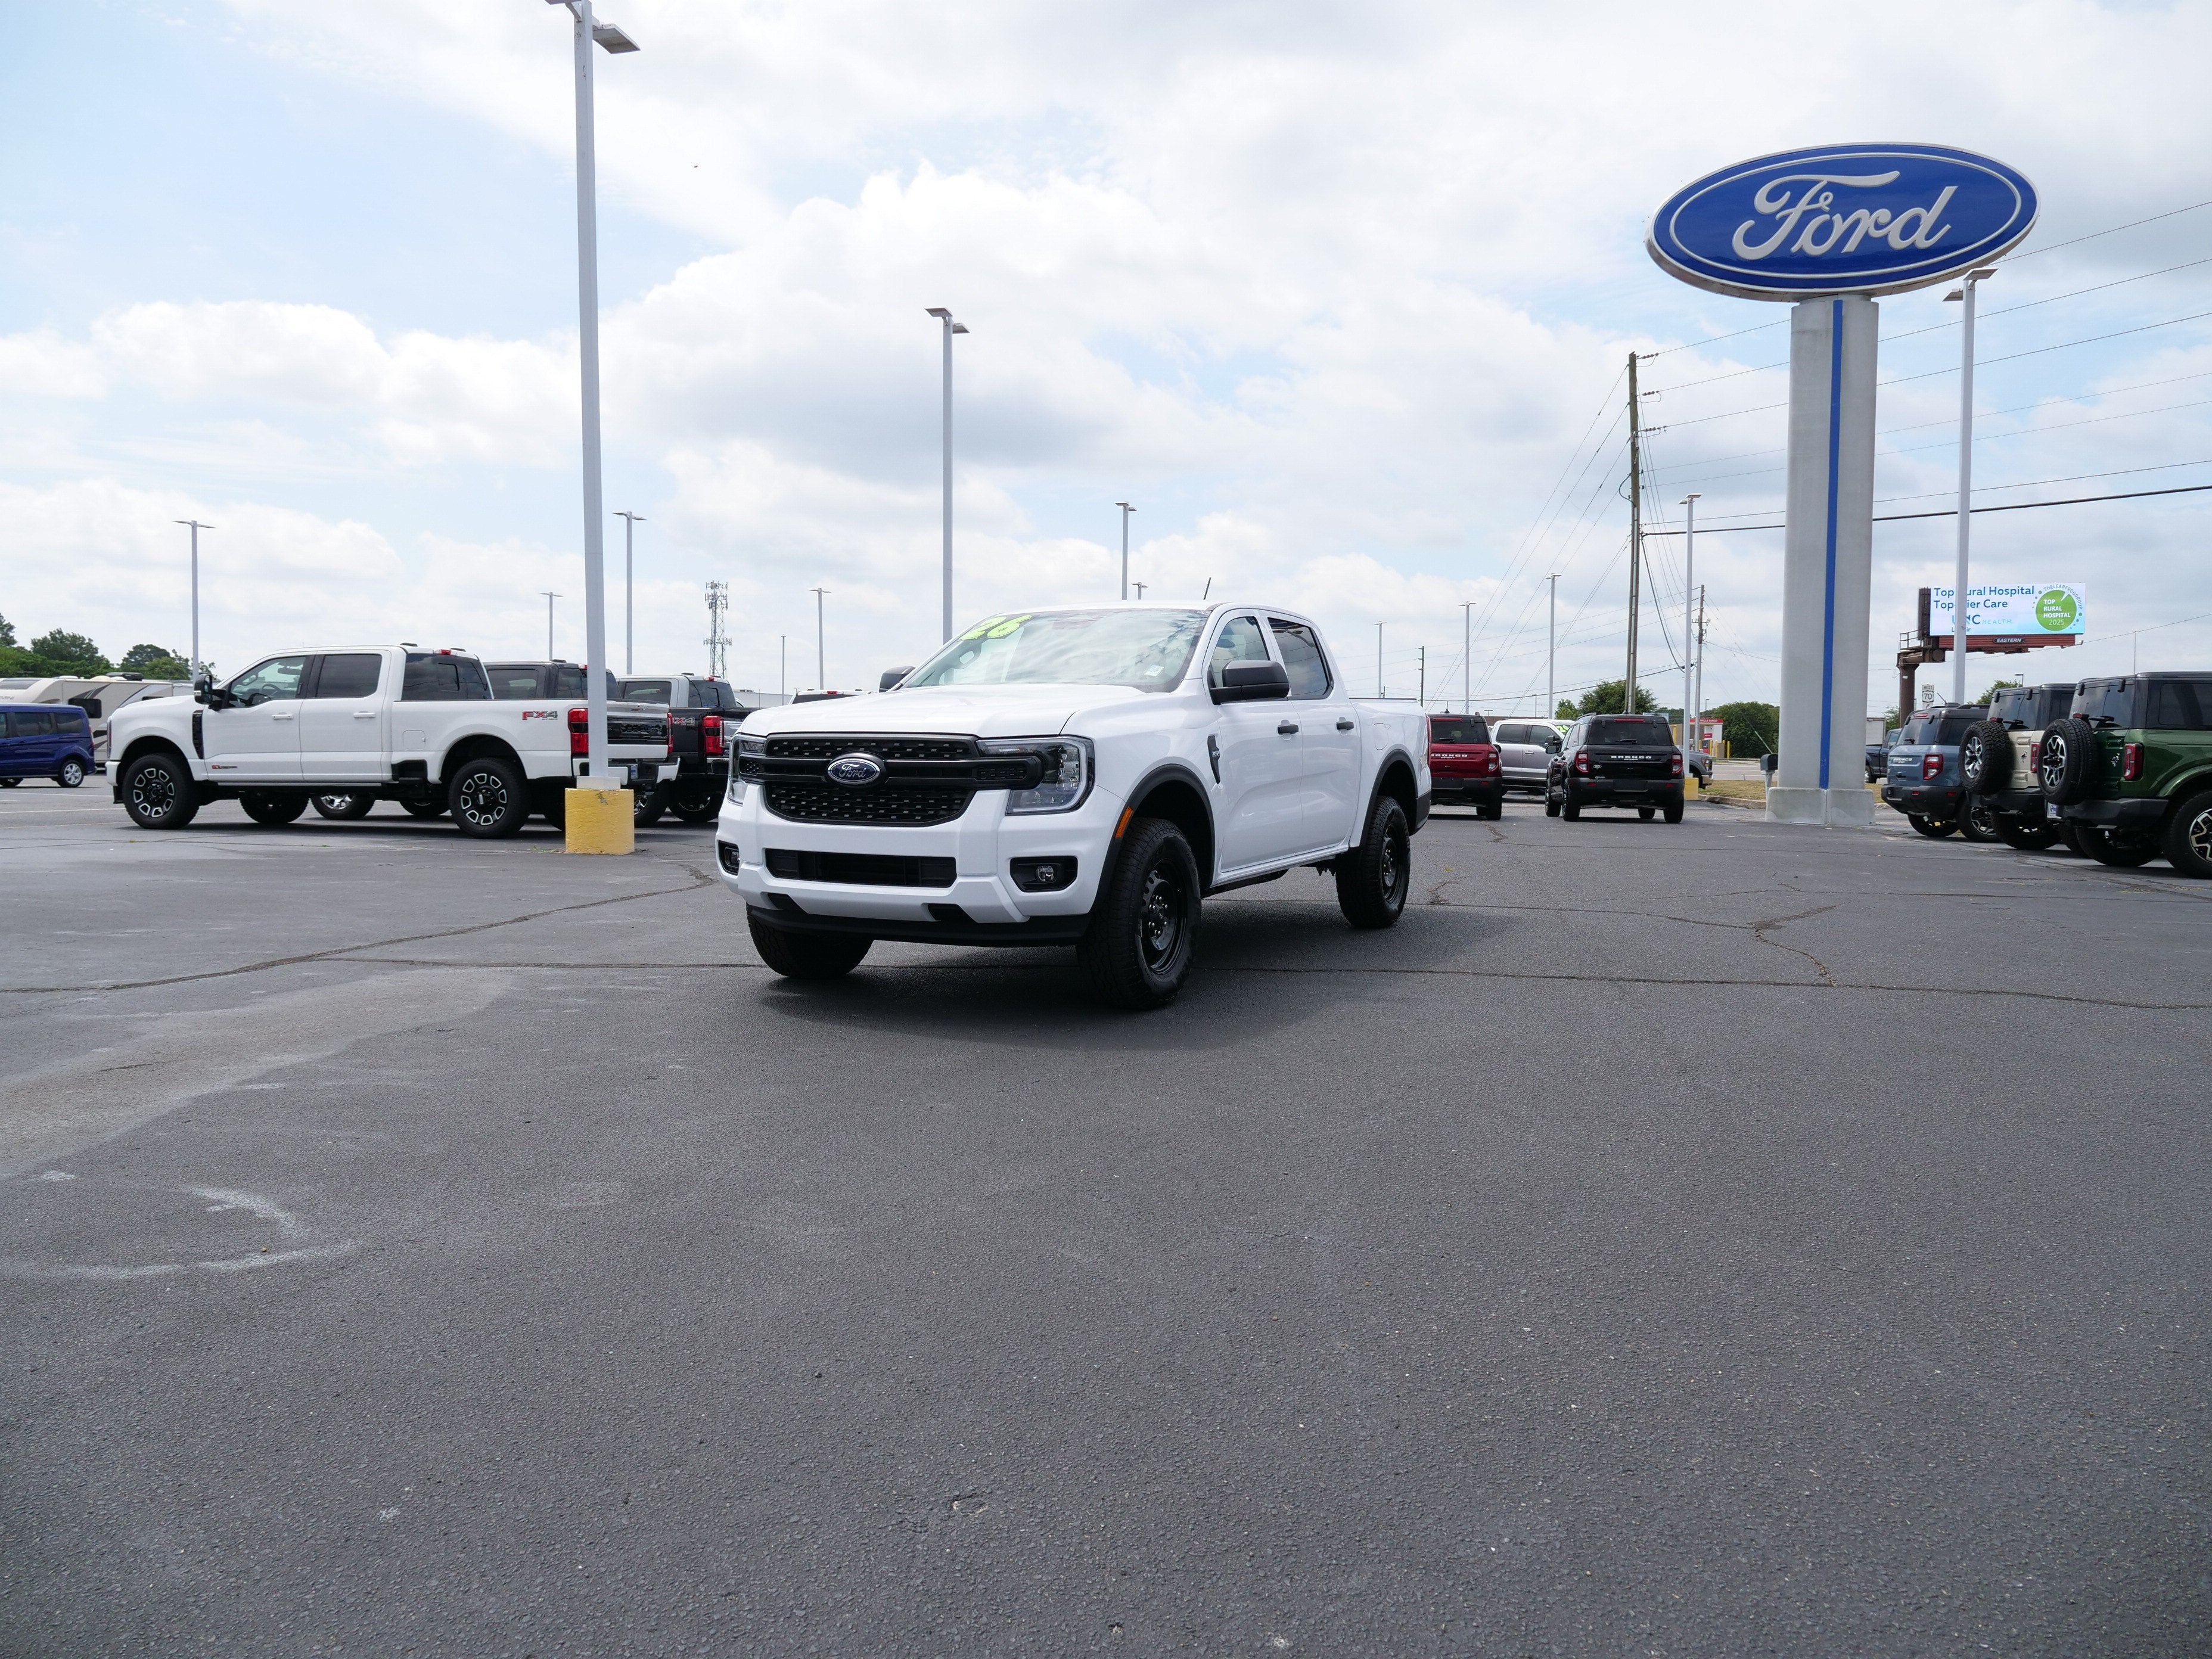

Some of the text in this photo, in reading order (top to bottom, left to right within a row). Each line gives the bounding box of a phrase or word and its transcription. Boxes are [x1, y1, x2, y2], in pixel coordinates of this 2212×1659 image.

[1732, 170, 1959, 260] Ford
[1934, 586, 2034, 598] Top ural Hospital
[1983, 599, 2008, 608] Care
[959, 616, 1032, 640] 26
[522, 710, 558, 720] FX4
[839, 763, 866, 778] Ford
